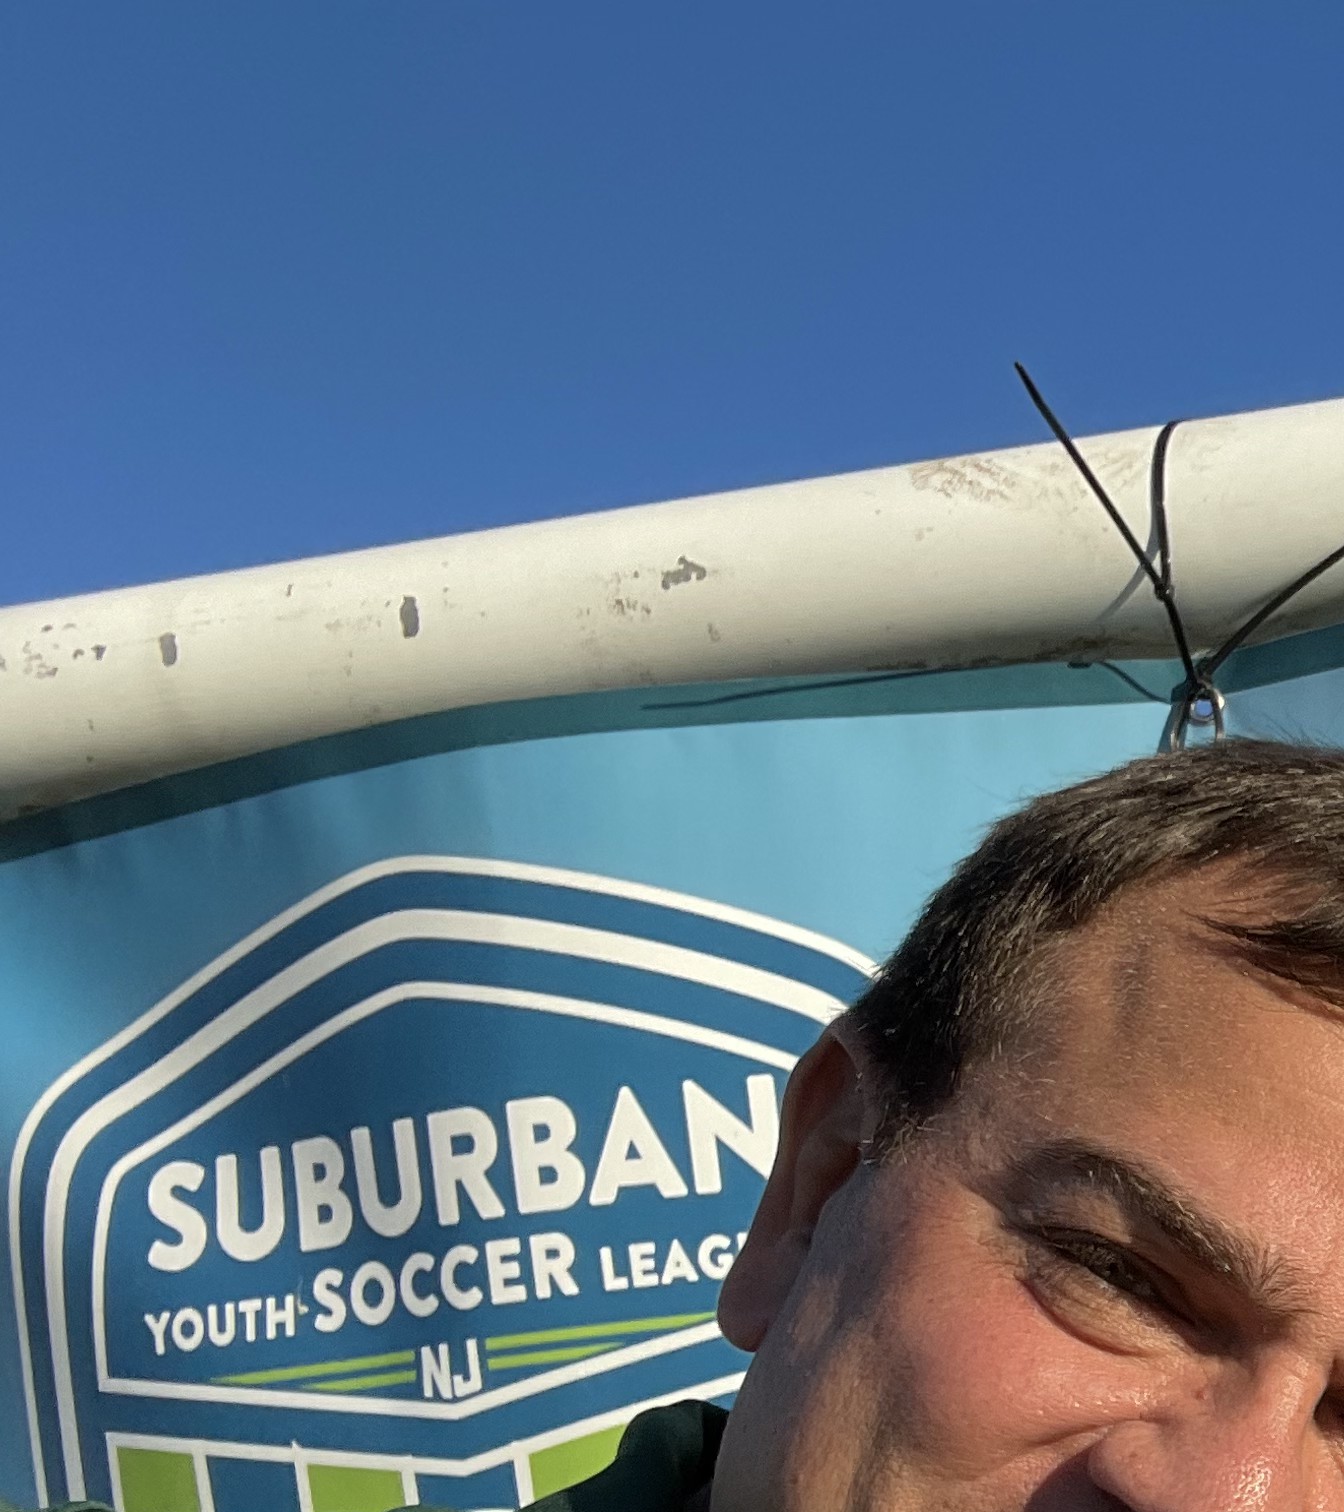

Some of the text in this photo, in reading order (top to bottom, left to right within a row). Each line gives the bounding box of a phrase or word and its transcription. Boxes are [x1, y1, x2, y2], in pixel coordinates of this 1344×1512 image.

[145, 1073, 779, 1273] SUBURBAN
[143, 1232, 750, 1357] YOUTH SOCCER LEAG
[419, 1339, 484, 1401] NJ
